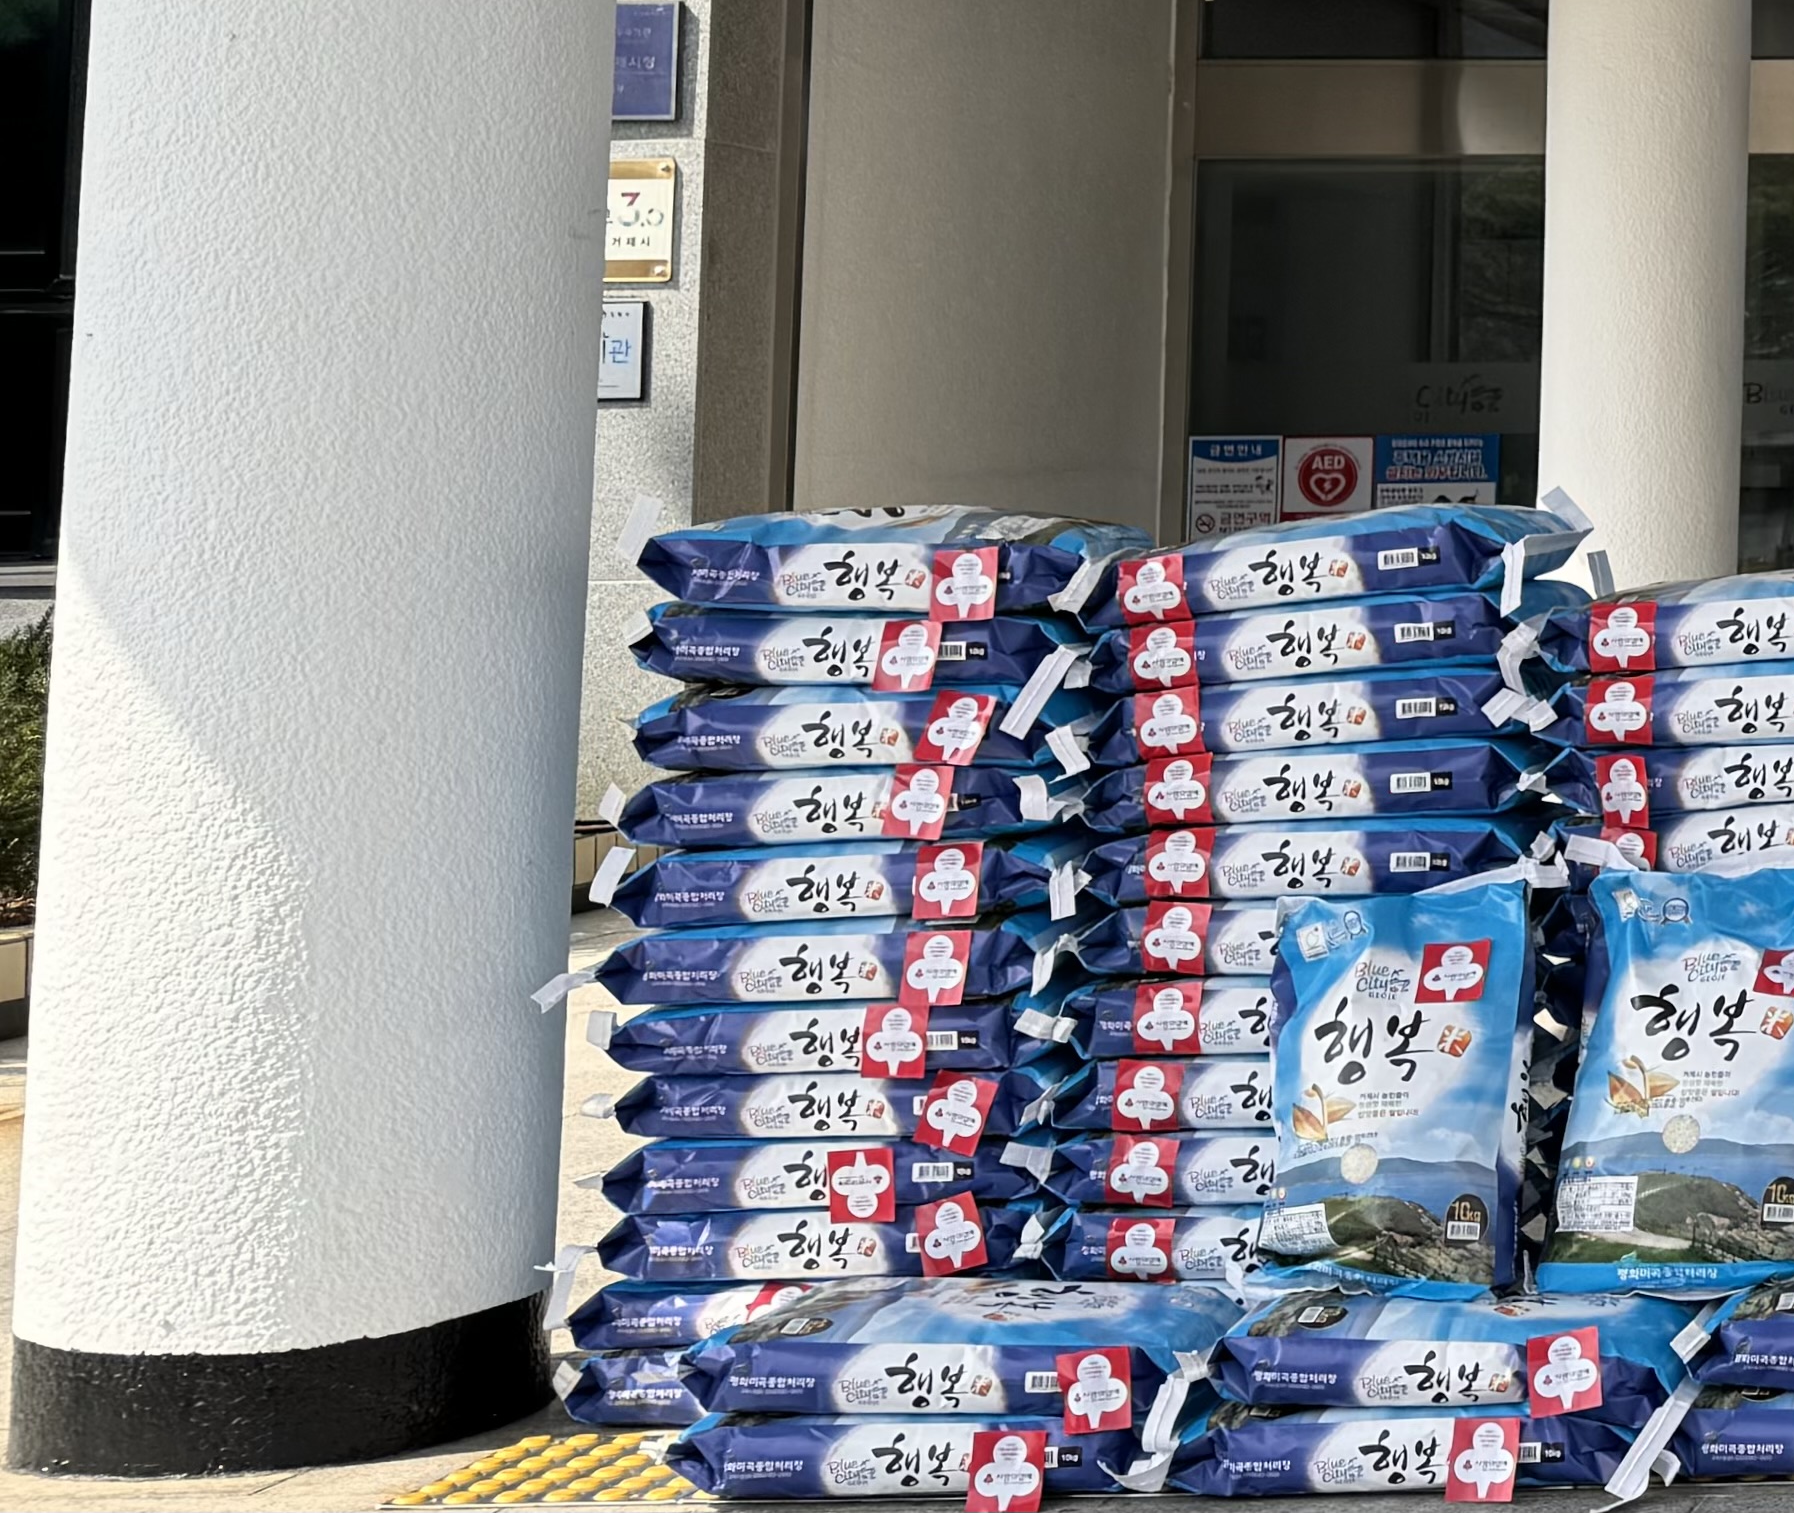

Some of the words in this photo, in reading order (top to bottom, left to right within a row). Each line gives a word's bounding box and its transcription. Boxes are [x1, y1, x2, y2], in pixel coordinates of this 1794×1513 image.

[1312, 454, 1345, 471] AED
[824, 551, 901, 600] 행복
[1250, 550, 1328, 595] 행복
[1267, 620, 1346, 667] 행복
[1716, 608, 1794, 657] 행복
[1268, 694, 1347, 742] 행복
[1715, 684, 1794, 733] 행복
[802, 711, 878, 758] 행복
[793, 786, 871, 834] 행복
[1264, 764, 1340, 812] 행복
[1263, 840, 1340, 888] 행복
[786, 865, 864, 915] 행복
[779, 945, 857, 994] 행복
[1314, 997, 1436, 1085] 행복
[1631, 984, 1755, 1062] 행복
[788, 1082, 866, 1131] 행복
[778, 1220, 859, 1270] 행복
[886, 1353, 969, 1410] 행복
[1405, 1351, 1491, 1402] 행복
[872, 1434, 961, 1487] 행복
[1360, 1430, 1449, 1485] 행복
